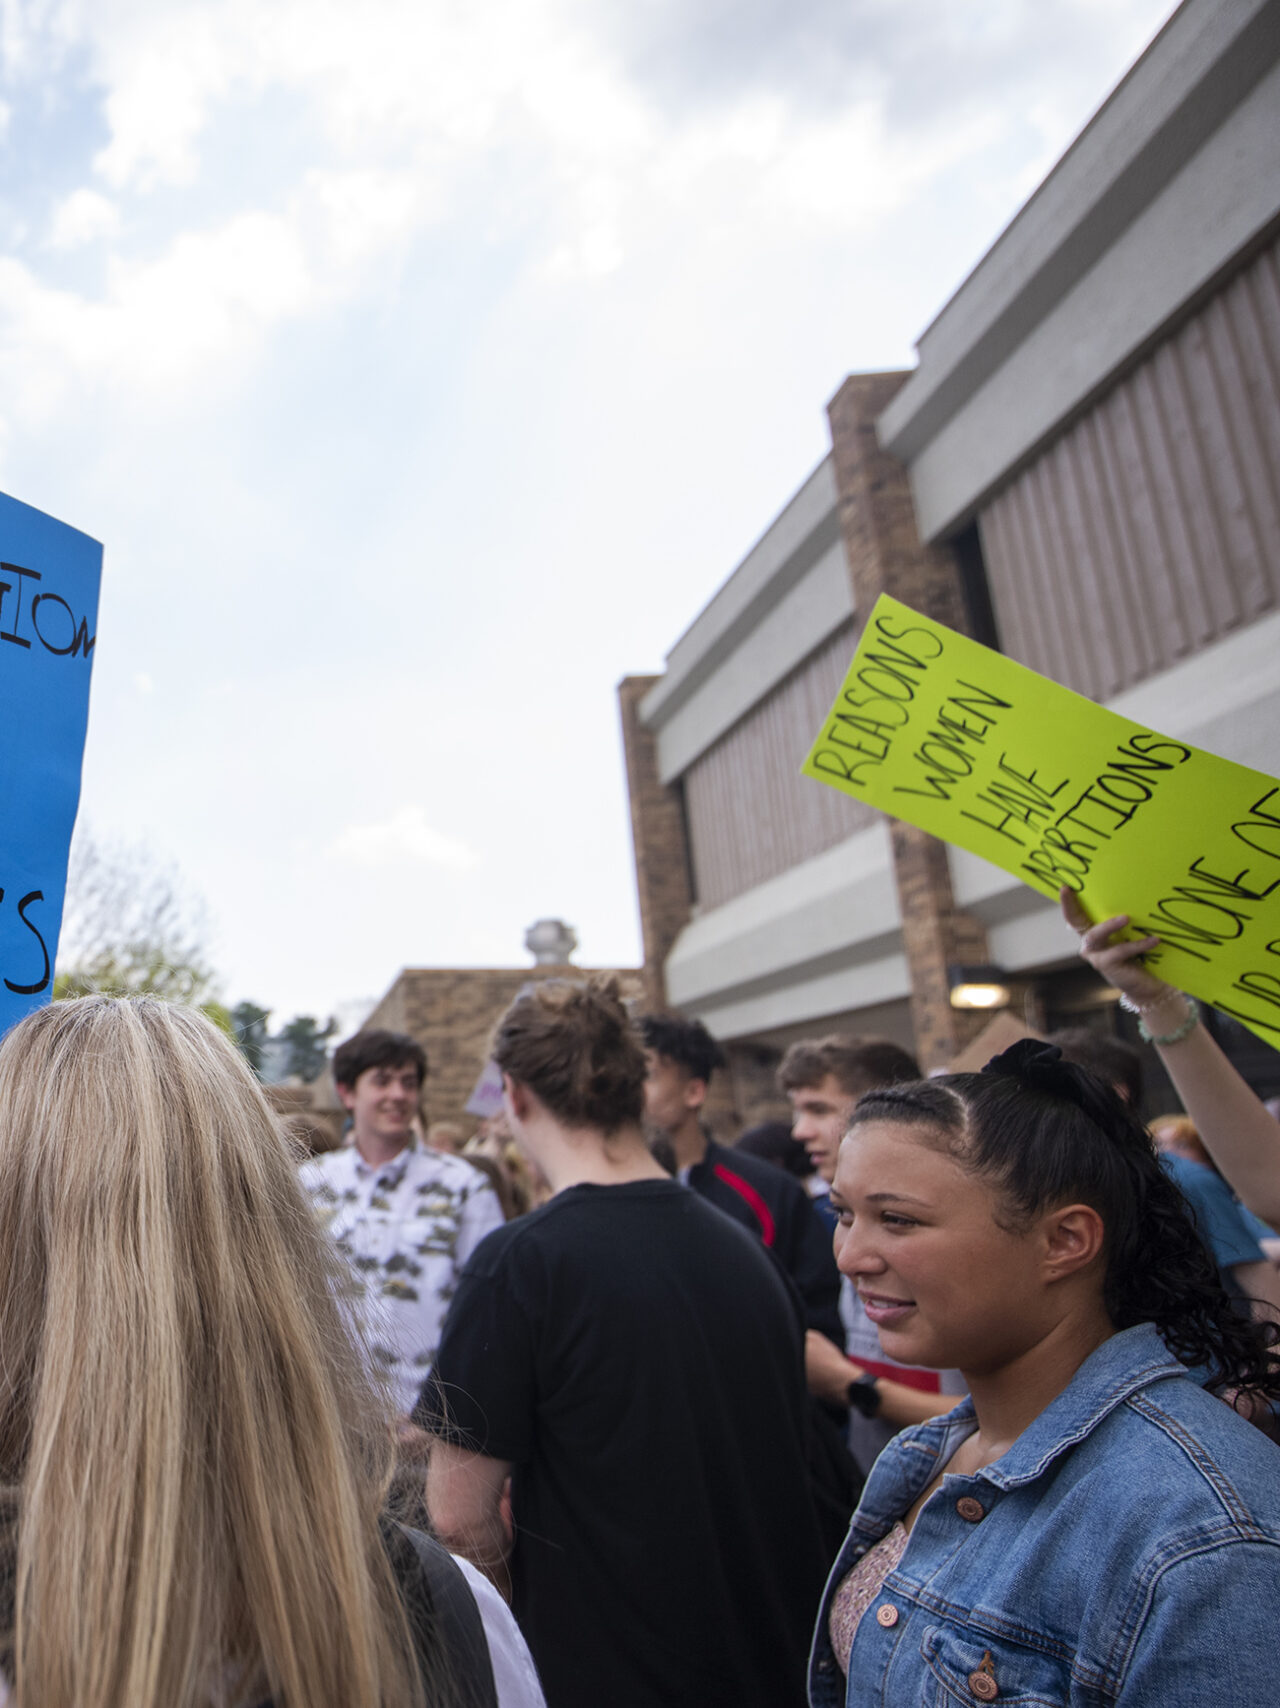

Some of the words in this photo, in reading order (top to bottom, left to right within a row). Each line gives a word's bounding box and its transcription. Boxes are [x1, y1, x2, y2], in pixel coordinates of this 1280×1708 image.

[813, 615, 943, 786] REASONS
[893, 679, 1013, 800] WOMEN
[960, 752, 1070, 846] HAVE
[1022, 734, 1192, 892] ABORTIONS
